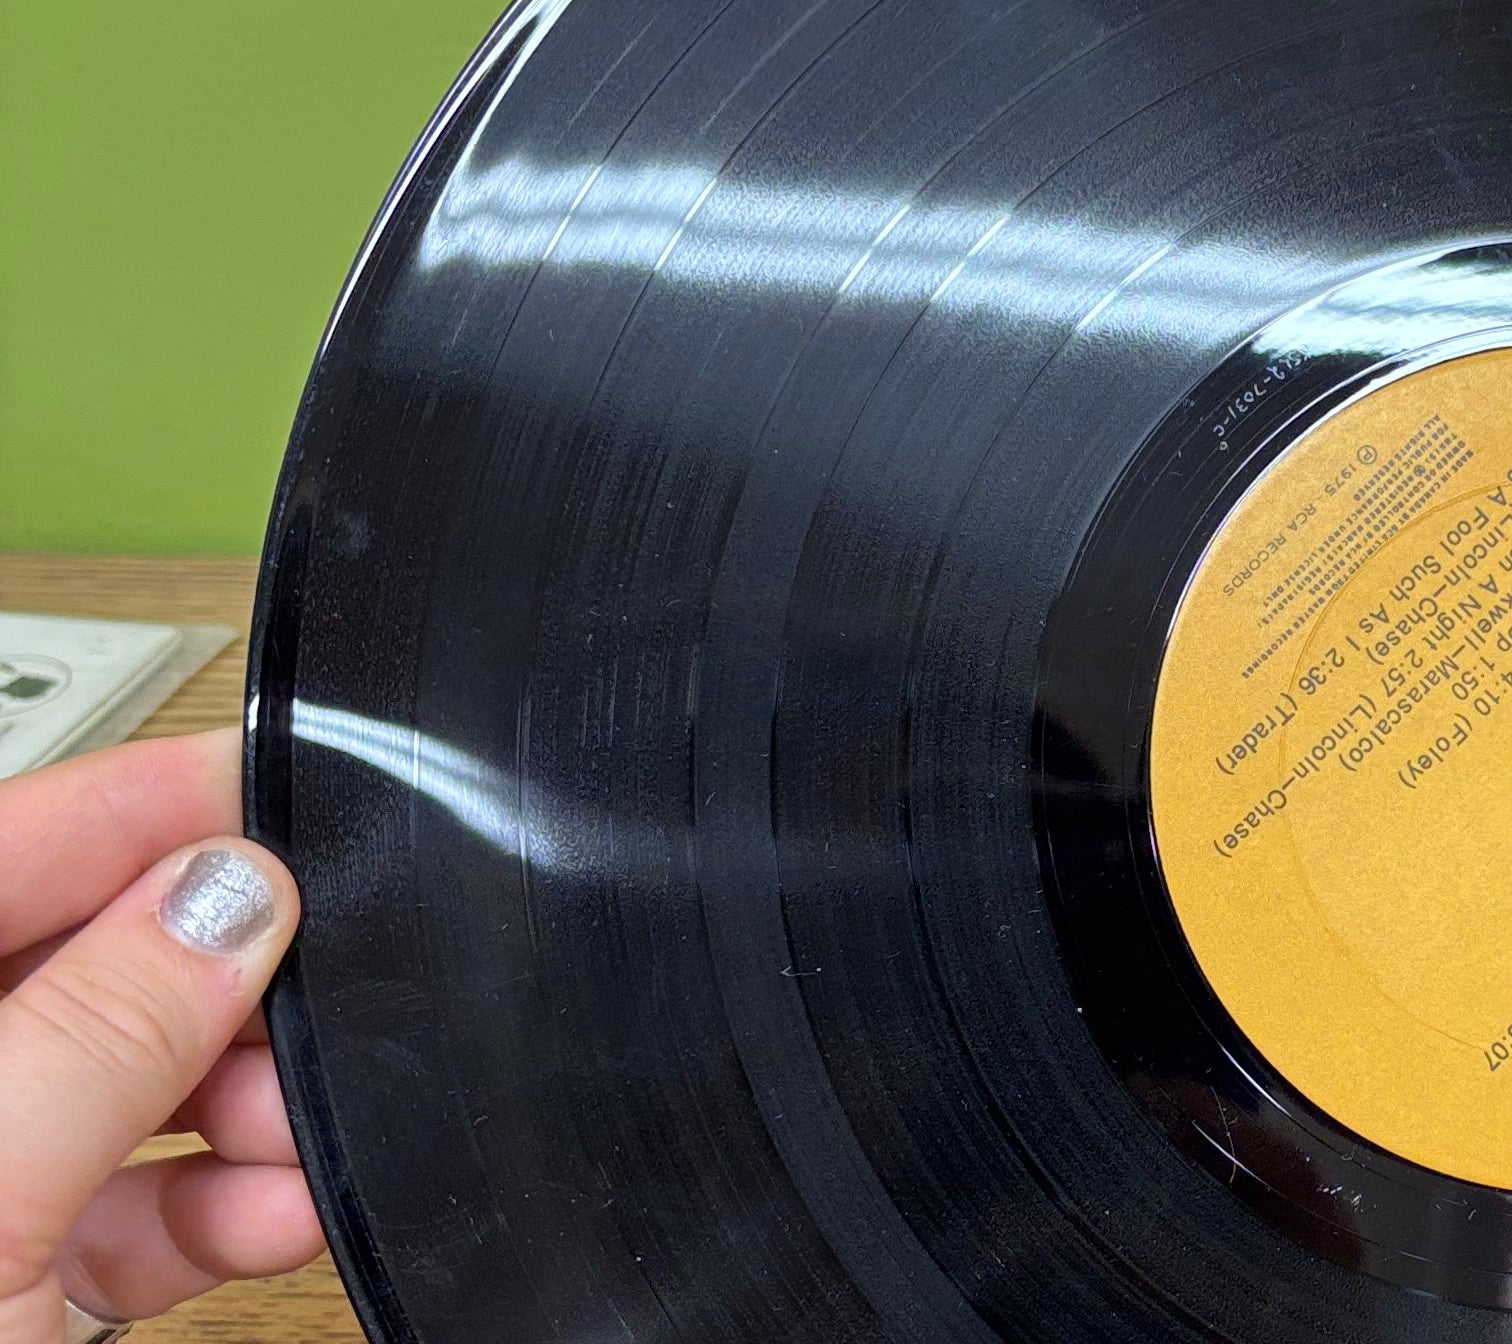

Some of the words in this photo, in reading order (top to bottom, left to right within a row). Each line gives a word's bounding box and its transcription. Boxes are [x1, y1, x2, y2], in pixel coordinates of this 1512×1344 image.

[1324, 464, 1357, 496] 1975
[1487, 486, 1507, 506] A
[1287, 504, 1316, 531] RCA
[1440, 507, 1489, 556] Fool
[1223, 533, 1287, 596] RECORDS
[1389, 555, 1441, 601] Such
[1478, 574, 1498, 593] A
[1359, 603, 1389, 633] As
[1422, 594, 1482, 650] Night
[1345, 636, 1360, 651] I
[1298, 648, 1344, 695] 2:36
[1381, 649, 1423, 697] 2:57
[1452, 657, 1495, 700] 1:50
[1216, 693, 1297, 775] (Trader)
[1398, 713, 1472, 789] (Foley)
[1214, 694, 1376, 858] (Lincoln-Chase)
